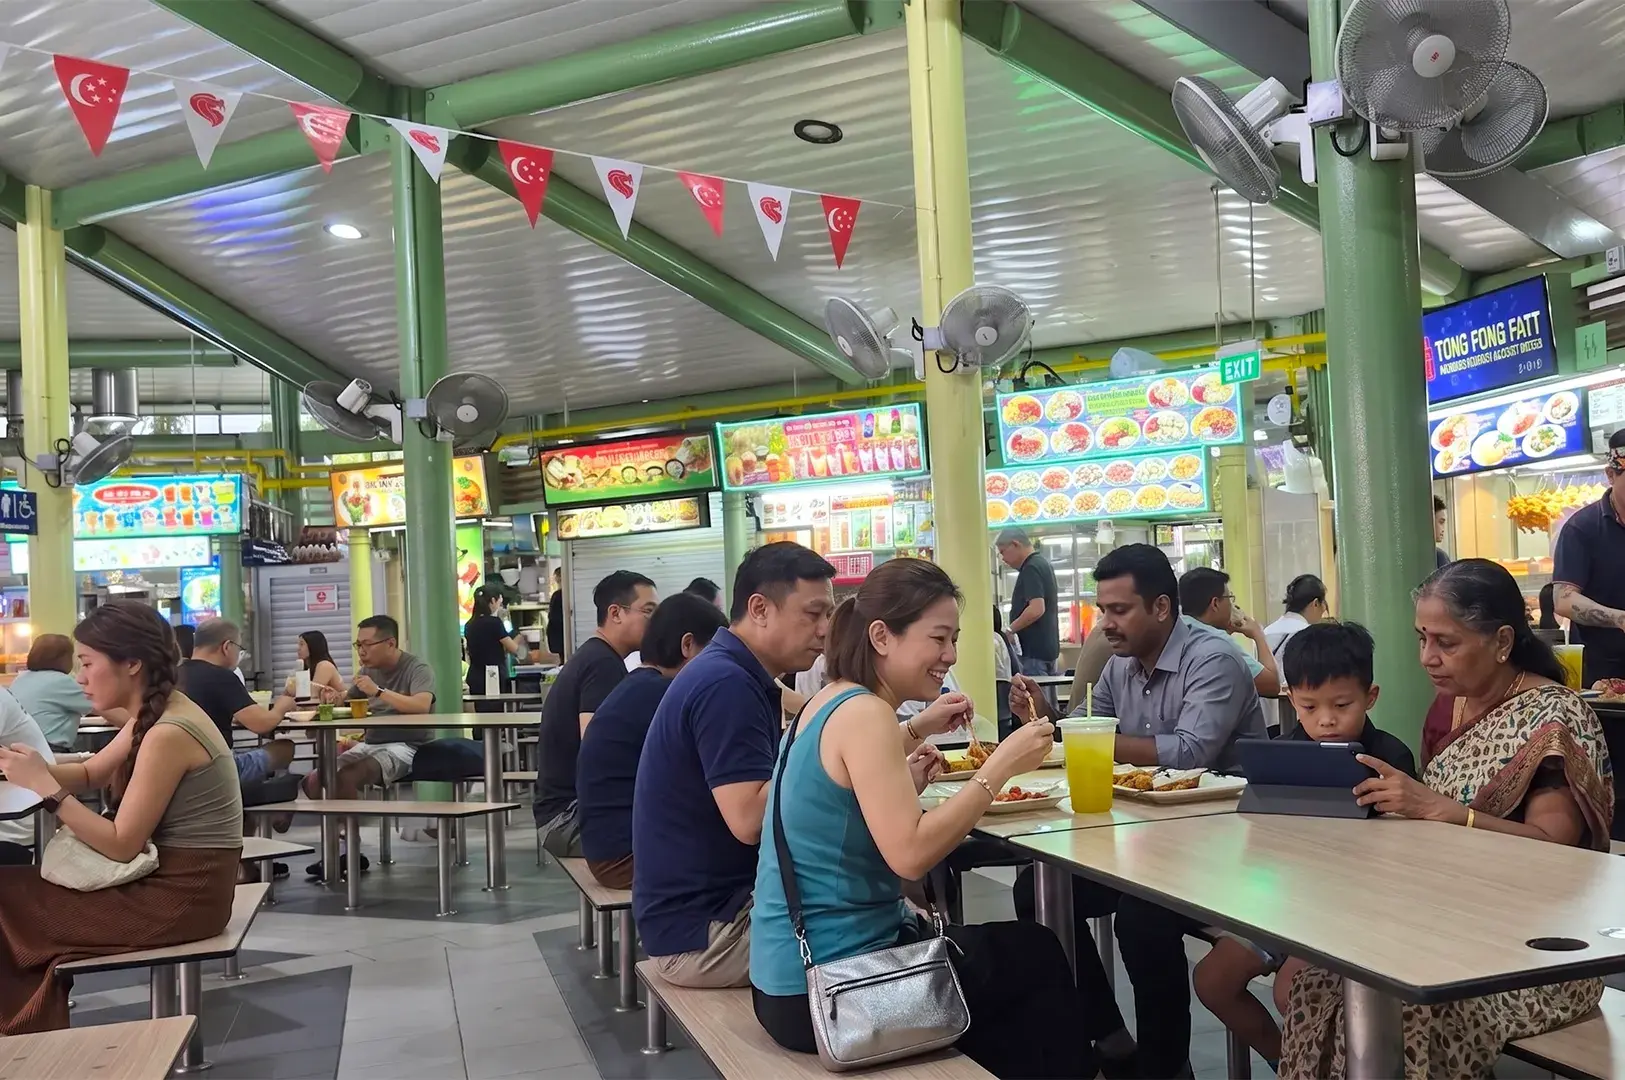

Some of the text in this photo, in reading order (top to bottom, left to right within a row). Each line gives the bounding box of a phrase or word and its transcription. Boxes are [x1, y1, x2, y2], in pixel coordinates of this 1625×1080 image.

[1434, 333, 1469, 362] TONG
[1470, 322, 1506, 352] FONG
[1508, 310, 1540, 342] FATT
[1225, 356, 1255, 382] EXIT
